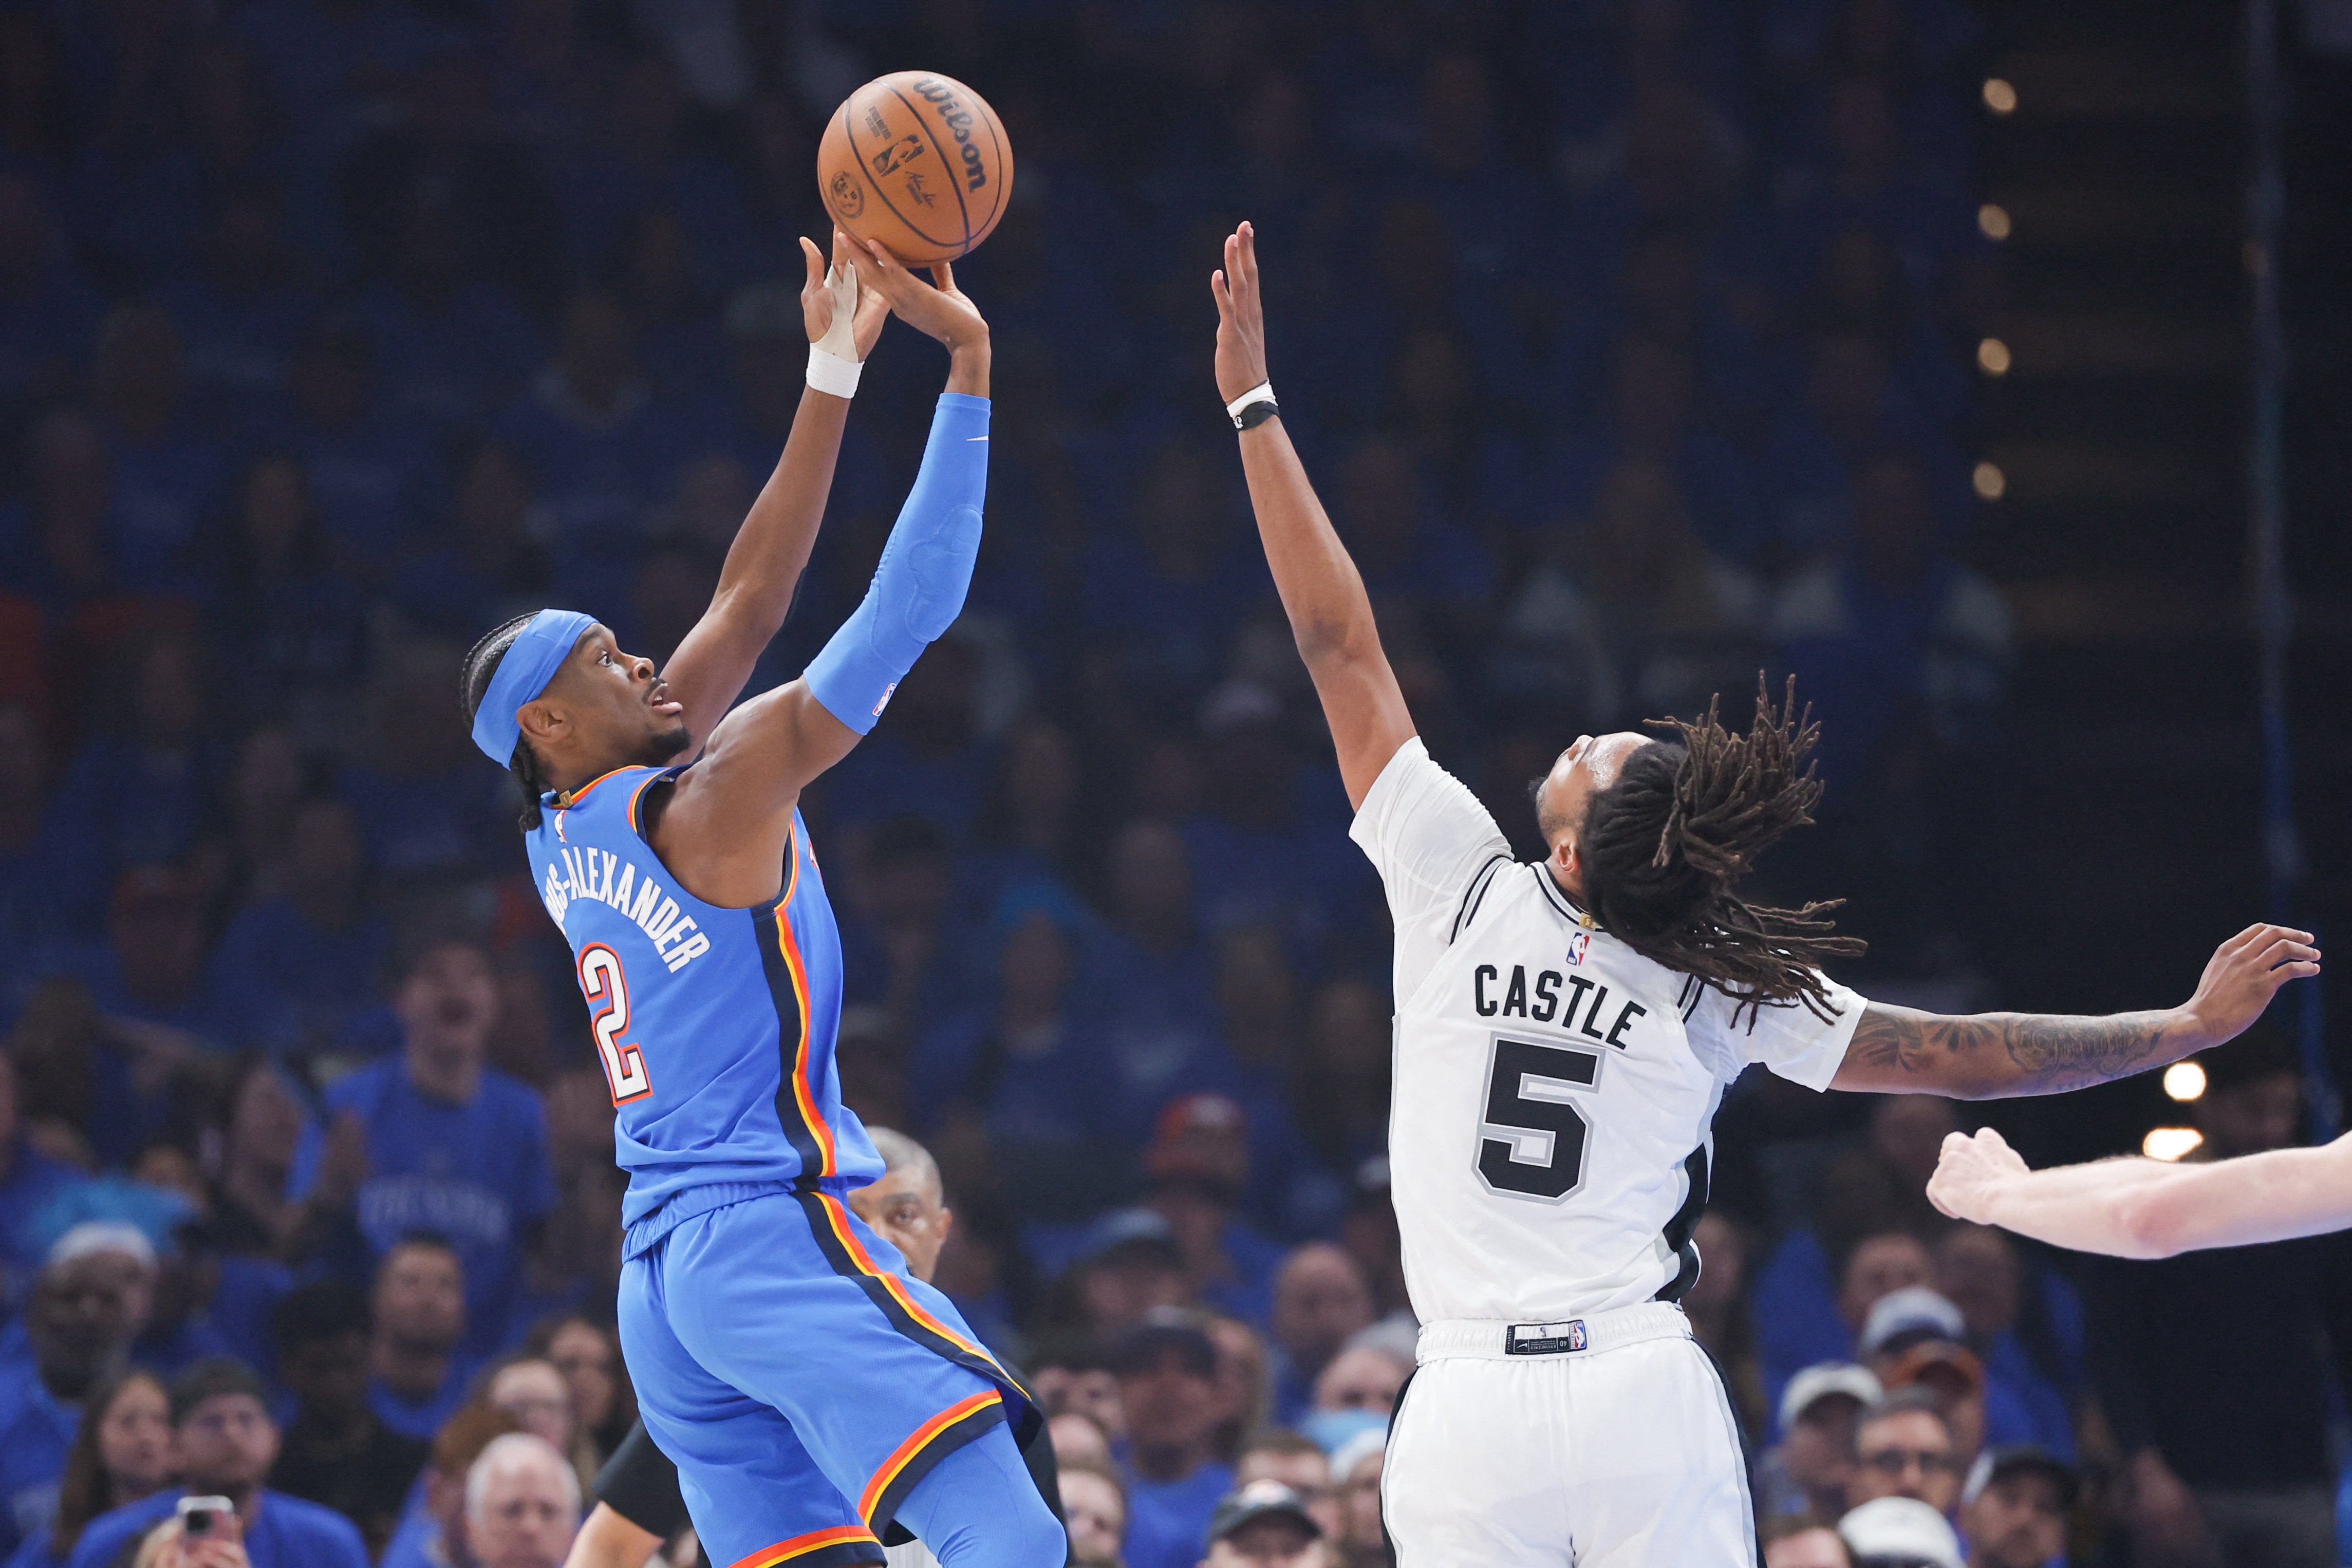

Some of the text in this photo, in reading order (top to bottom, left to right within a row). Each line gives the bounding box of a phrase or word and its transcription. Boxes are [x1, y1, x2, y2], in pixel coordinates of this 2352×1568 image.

[913, 79, 986, 193] Wilson
[577, 942, 654, 1107] 2
[1474, 964, 1647, 1051] CASTLE
[1471, 1030, 1607, 1206] 5
